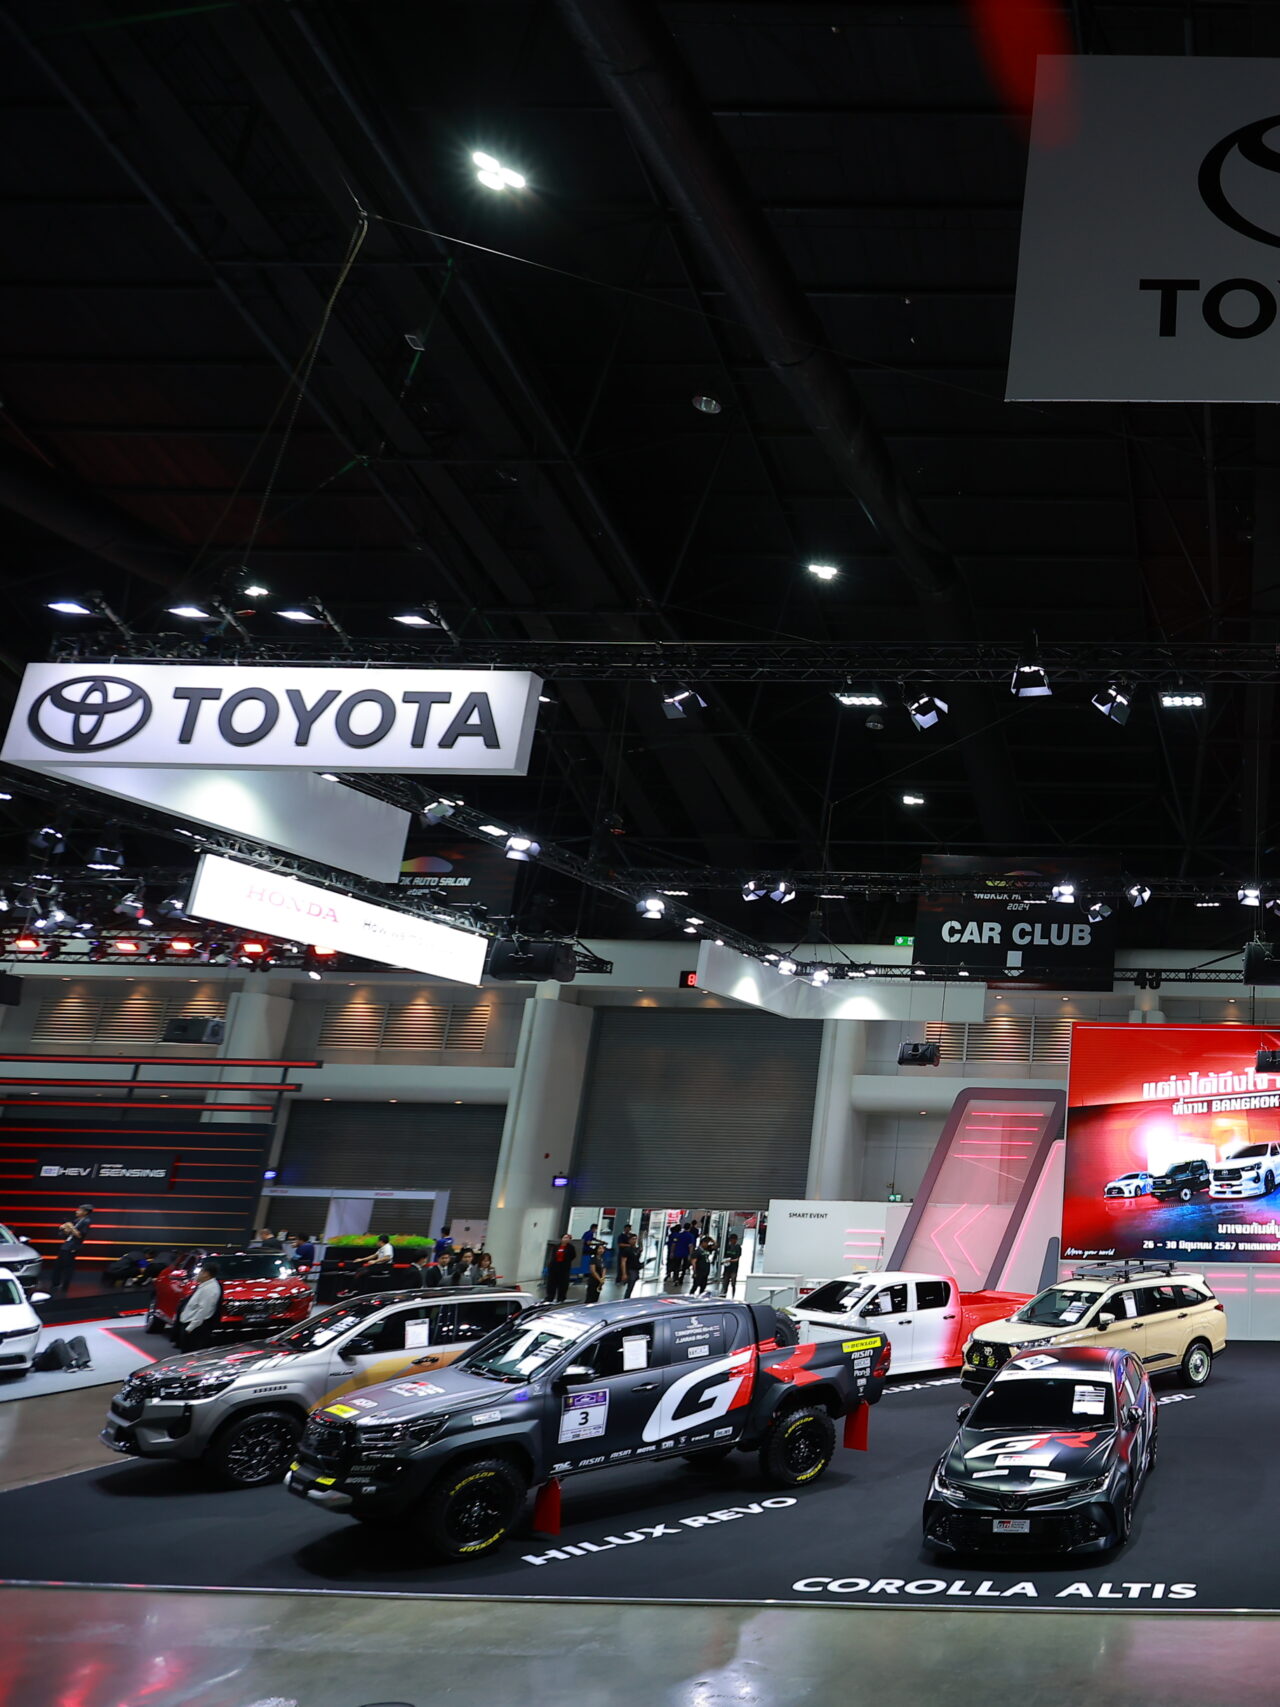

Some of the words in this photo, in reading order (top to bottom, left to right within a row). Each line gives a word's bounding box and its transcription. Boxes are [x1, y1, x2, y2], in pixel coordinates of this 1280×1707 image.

[173, 688, 501, 750] TOYOTA
[245, 885, 340, 924] HONDA
[1006, 903, 1030, 911] 2024
[942, 921, 1002, 944] CAR
[1012, 923, 1091, 946] CLUB
[1212, 1095, 1280, 1112] BANGKOK
[99, 1168, 166, 1178] SENSING
[1143, 1240, 1155, 1249] 26
[1165, 1240, 1177, 1249] 30
[1214, 1242, 1235, 1250] 2567
[851, 1349, 874, 1359] AISIN
[579, 1410, 589, 1426] 3
[964, 1431, 1098, 1460] GR
[578, 1456, 605, 1467] AISIN
[521, 1524, 682, 1566] HILUX
[678, 1497, 798, 1528] REVO
[792, 1577, 1038, 1597] COROLLA
[1055, 1582, 1198, 1599] ALTIS
